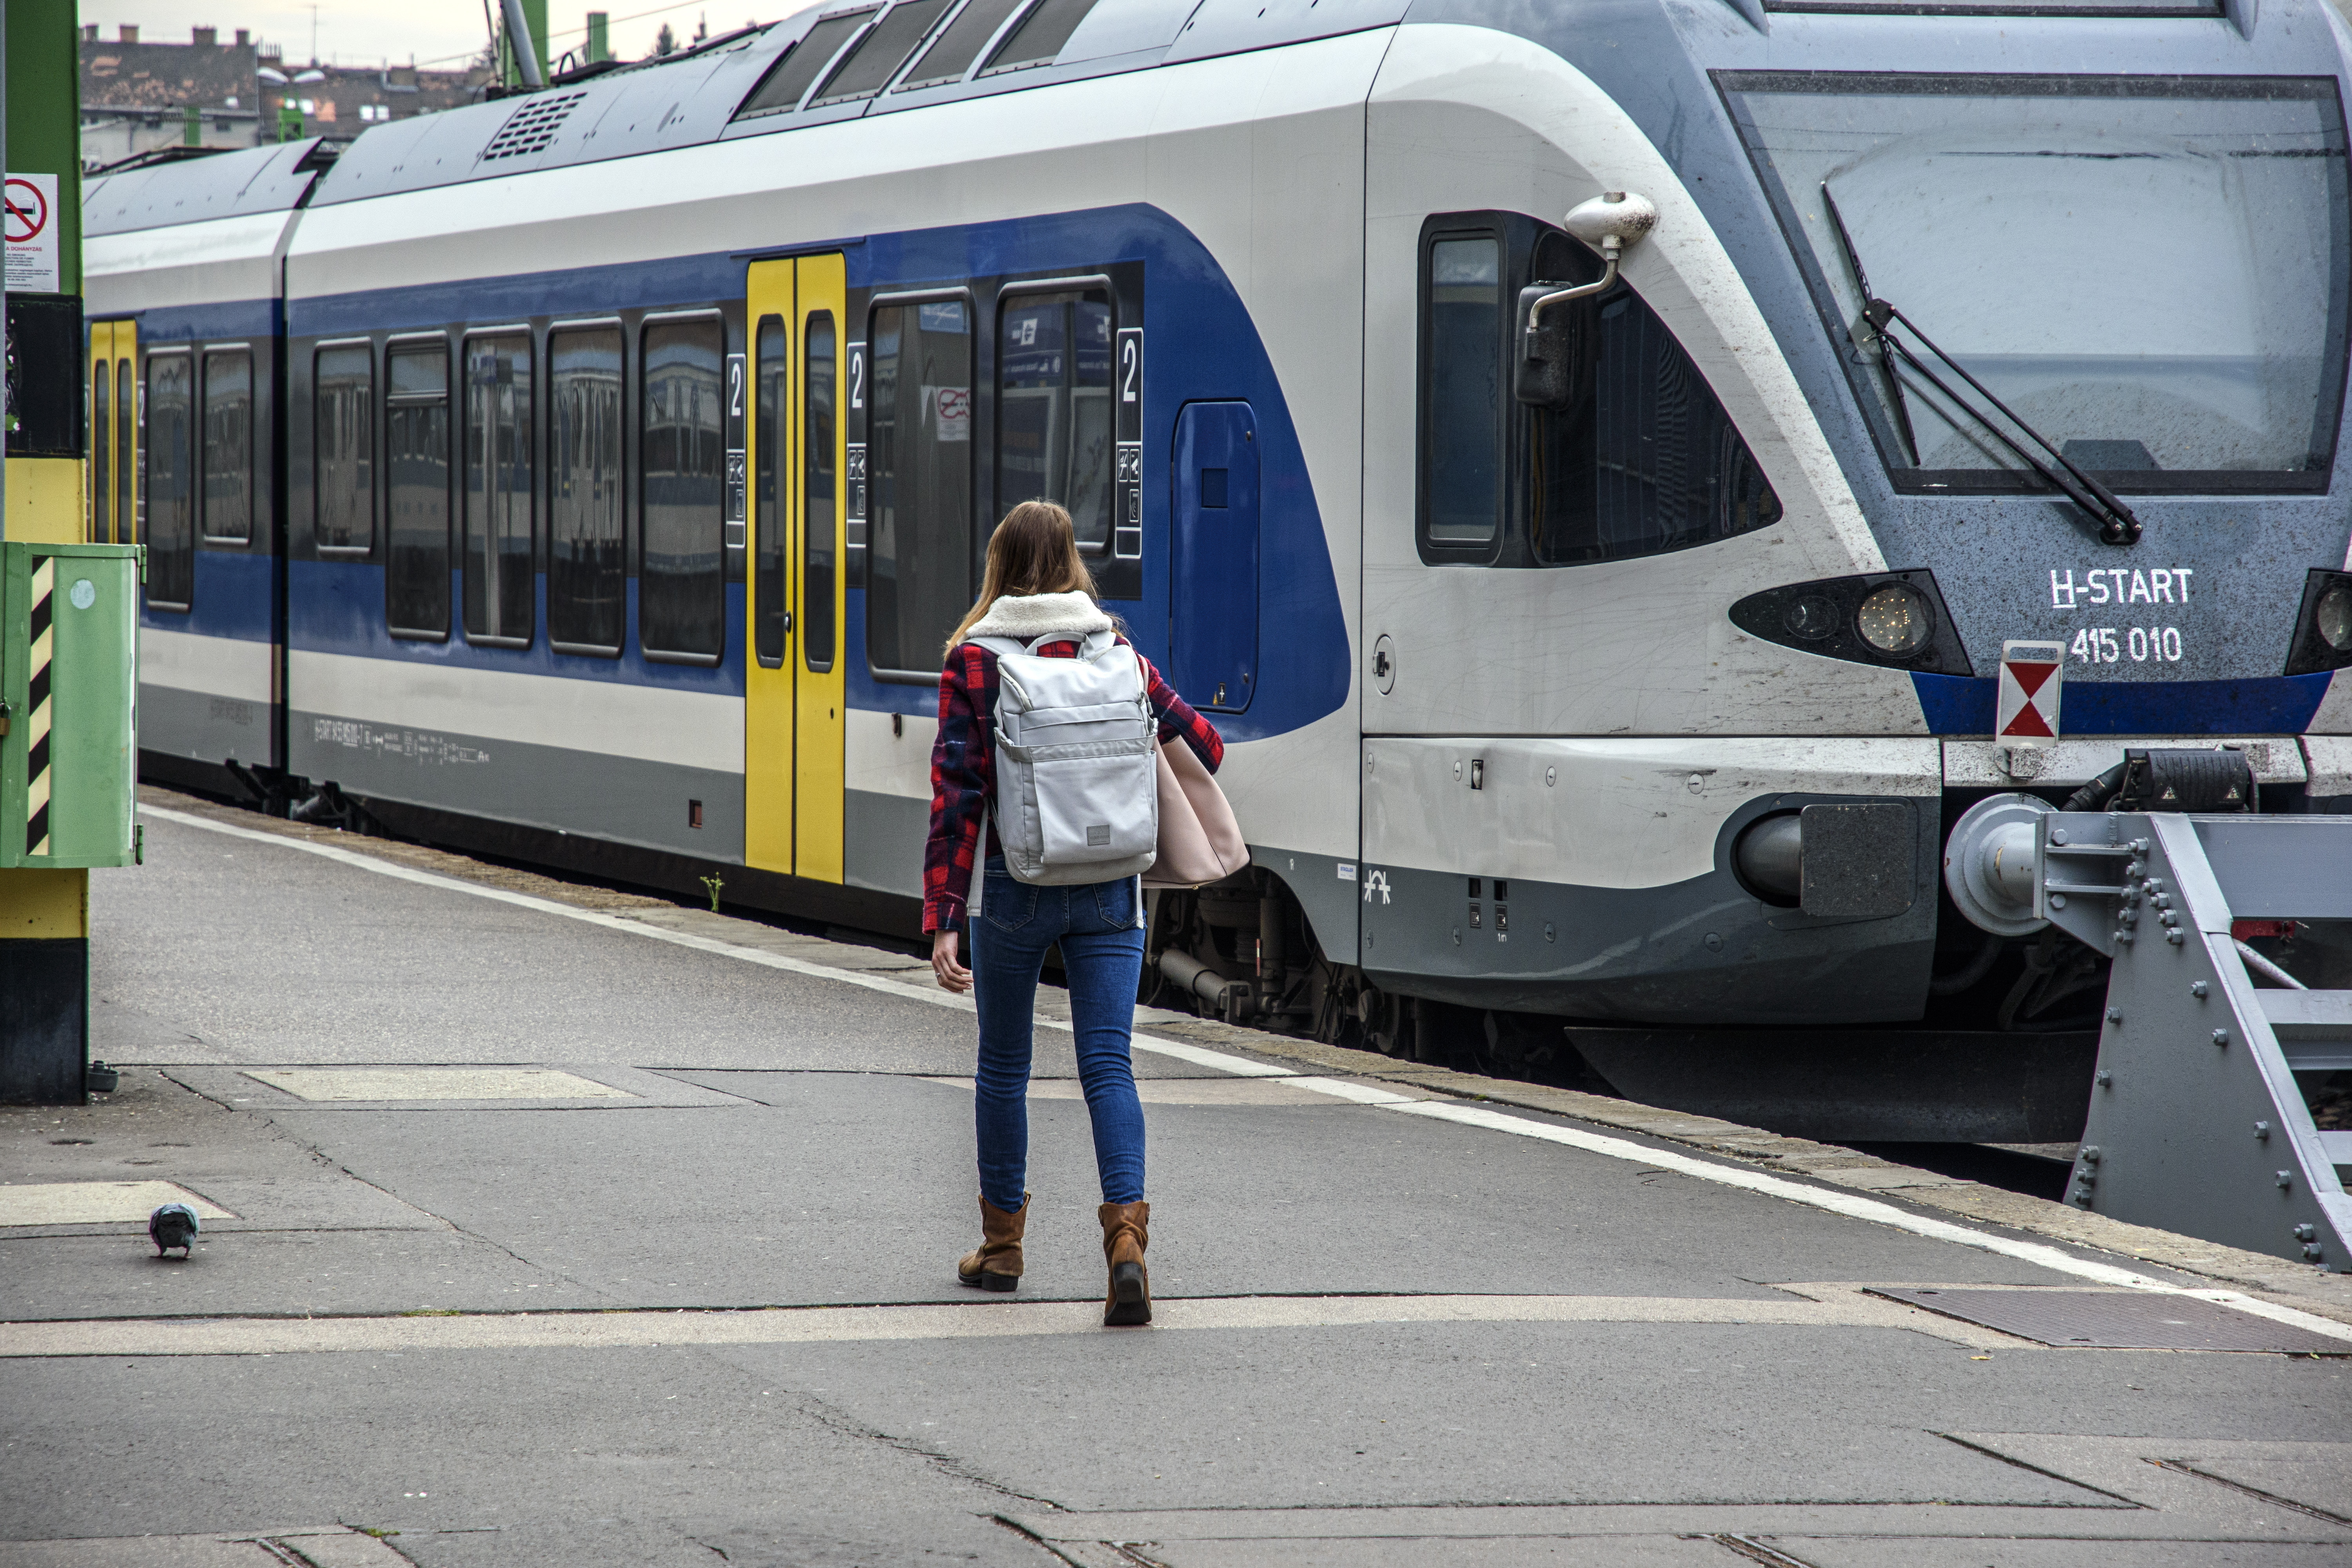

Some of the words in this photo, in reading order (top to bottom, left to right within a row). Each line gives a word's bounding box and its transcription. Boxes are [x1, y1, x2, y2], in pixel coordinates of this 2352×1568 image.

[731, 363, 741, 416] 2
[852, 352, 862, 408] 2
[1123, 339, 1136, 402] 2
[139, 388, 144, 426] 2
[2050, 569, 2192, 606] H-START
[2071, 627, 2119, 663] 415
[2129, 627, 2182, 662] 010
